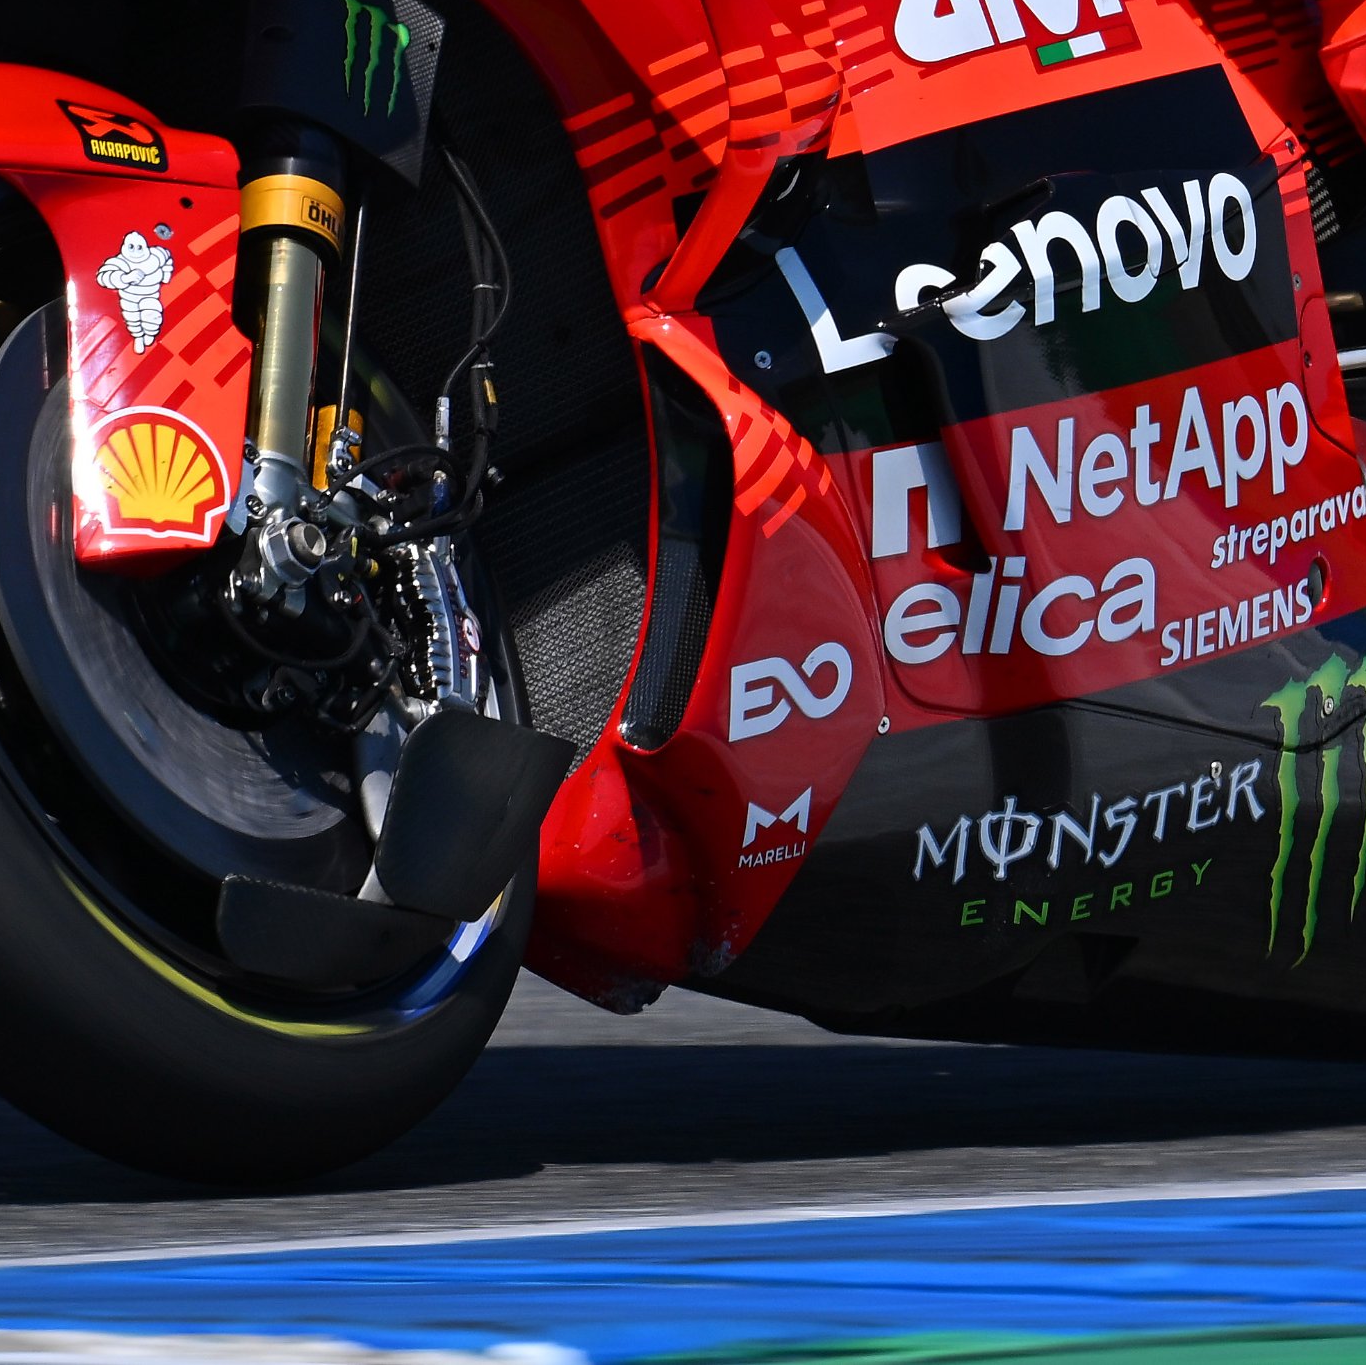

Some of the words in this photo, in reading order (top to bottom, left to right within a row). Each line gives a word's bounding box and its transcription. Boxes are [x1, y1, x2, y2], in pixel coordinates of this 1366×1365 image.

[773, 171, 1258, 375] Lenovo
[1002, 381, 1309, 532] NetApp
[883, 555, 1157, 665] elica
[1159, 577, 1313, 667] SIEMENS
[737, 839, 806, 870] MARELLI
[911, 757, 1266, 884] MONSTER
[960, 859, 1213, 927] ENERGY
